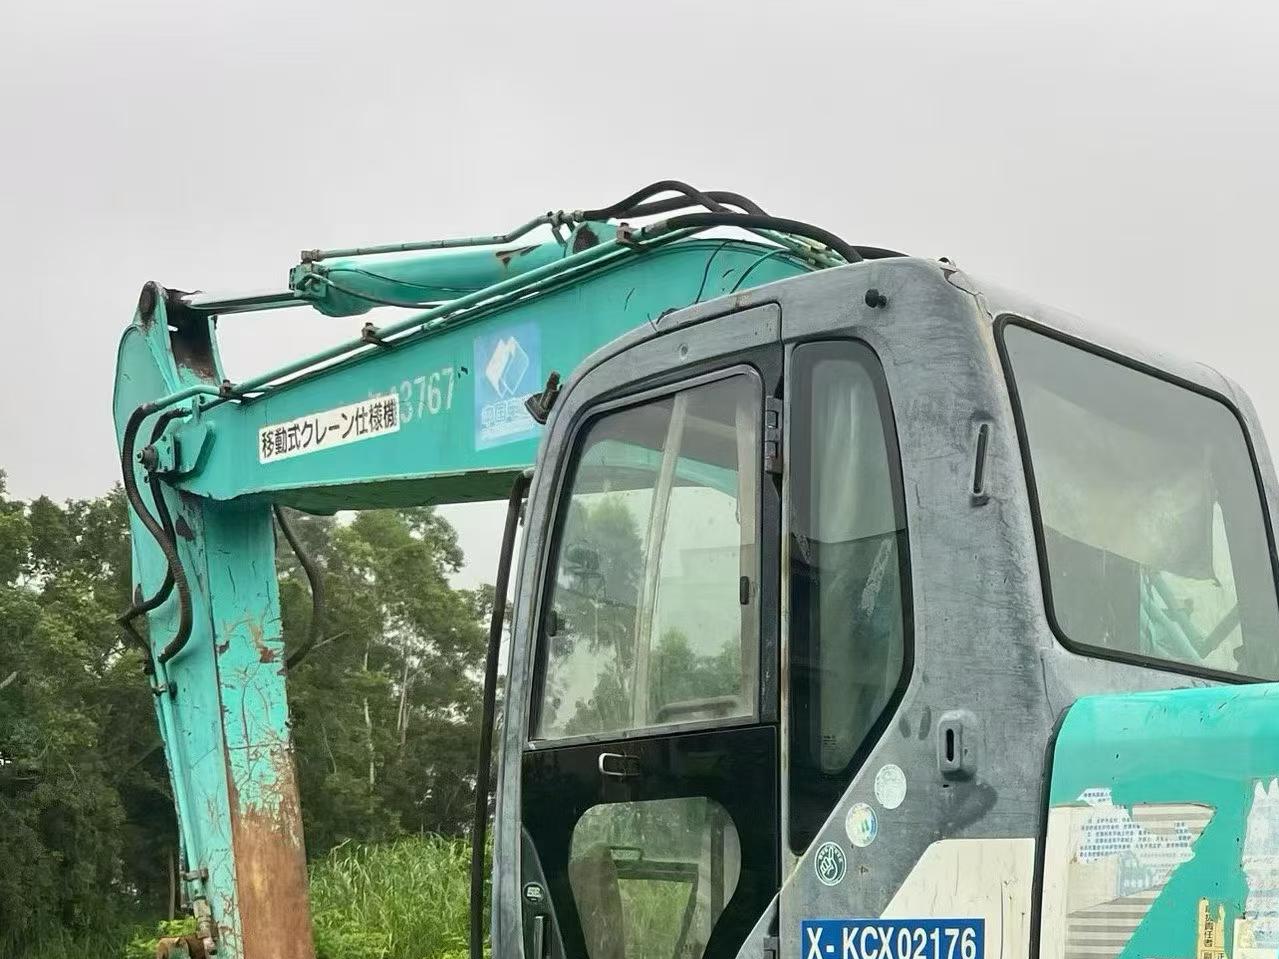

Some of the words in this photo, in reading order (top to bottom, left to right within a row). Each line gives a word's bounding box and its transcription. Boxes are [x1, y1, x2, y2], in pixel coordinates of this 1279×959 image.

[261, 399, 398, 459] 移動式クレーン仕様機
